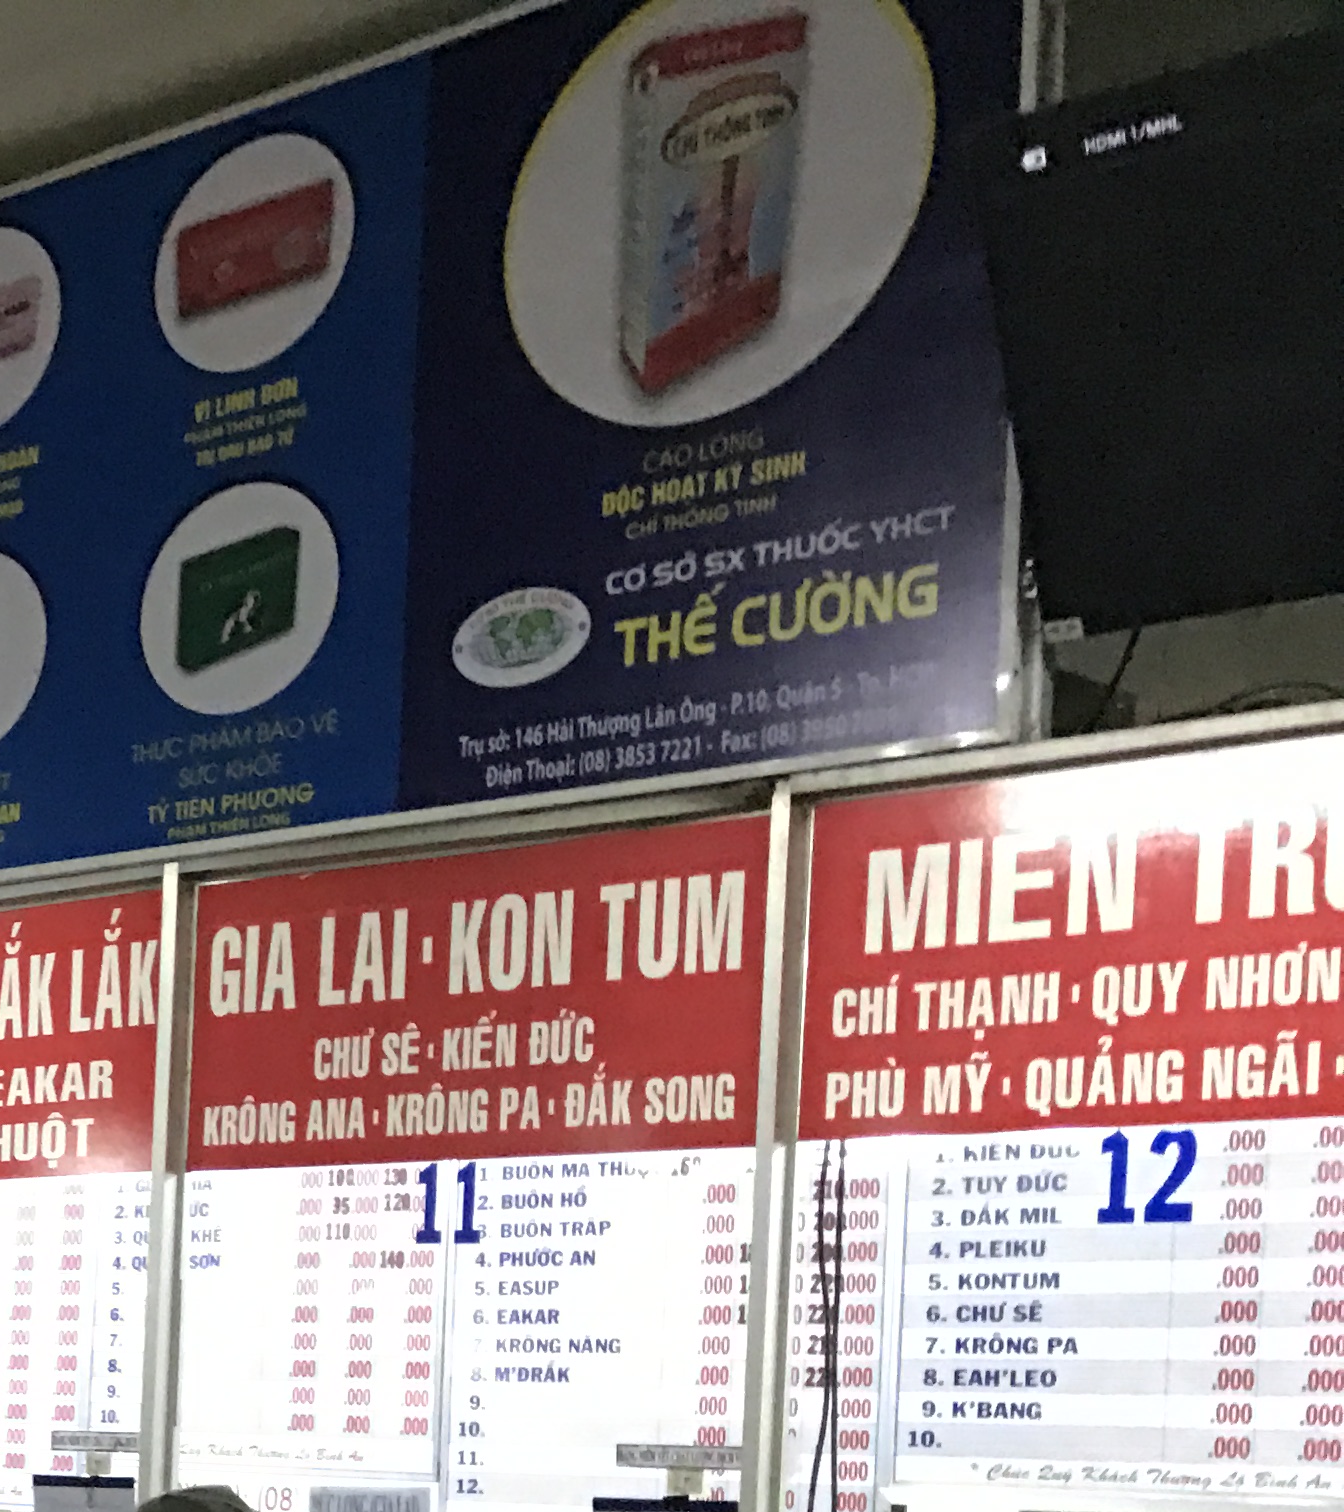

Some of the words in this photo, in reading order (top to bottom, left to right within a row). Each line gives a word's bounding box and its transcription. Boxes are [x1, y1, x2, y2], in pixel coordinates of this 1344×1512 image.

[1084, 128, 1126, 156] HDMI
[751, 449, 806, 485] SINH
[704, 548, 745, 578] SX
[753, 518, 861, 567] THUỐC
[870, 505, 955, 544] YHCT
[615, 582, 726, 668] THẾ
[732, 562, 939, 647] CƯỜNG
[516, 725, 543, 747] 146
[578, 747, 611, 775] (08)
[616, 743, 655, 766] 3853
[661, 739, 702, 762] 7221
[720, 728, 758, 752] Fax:
[211, 922, 297, 1017] GIA
[318, 908, 408, 1008] LAI
[448, 889, 574, 996] KON
[599, 871, 746, 982] TUM
[832, 975, 899, 1038] CHÍ
[915, 971, 1061, 1041] THẠNH
[1092, 960, 1188, 1025] QUY
[1206, 942, 1343, 1011] NHƠN
[381, 1023, 420, 1076] SÊ
[442, 1010, 517, 1071] KIẾN
[529, 1008, 595, 1066] ĐỨC
[922, 1052, 992, 1116] MỸ
[1025, 1035, 1185, 1117] QUẢNG
[1201, 1030, 1321, 1101] NGÃI
[203, 1095, 296, 1147] KRÔNG
[306, 1098, 365, 1141] ANA
[386, 1083, 488, 1138] KRÔNG
[500, 1086, 541, 1132] PA
[644, 1074, 736, 1125] SONG
[562, 1164, 590, 1178] MA
[1097, 1128, 1198, 1224] 12
[963, 1177, 1008, 1194] TUY
[416, 1162, 480, 1244] 11
[1020, 1207, 1062, 1224] MIL
[570, 1250, 596, 1266] AN
[959, 1240, 1046, 1258] PLEIKU
[499, 1280, 559, 1296] EASUP
[958, 1272, 1060, 1290] KONTUM
[497, 1309, 559, 1324] EAKAR
[1048, 1337, 1078, 1355] PA
[953, 1369, 1058, 1387] EAH'LEO
[952, 1402, 1042, 1420] K'BANG
[908, 1431, 942, 1448] 10.
